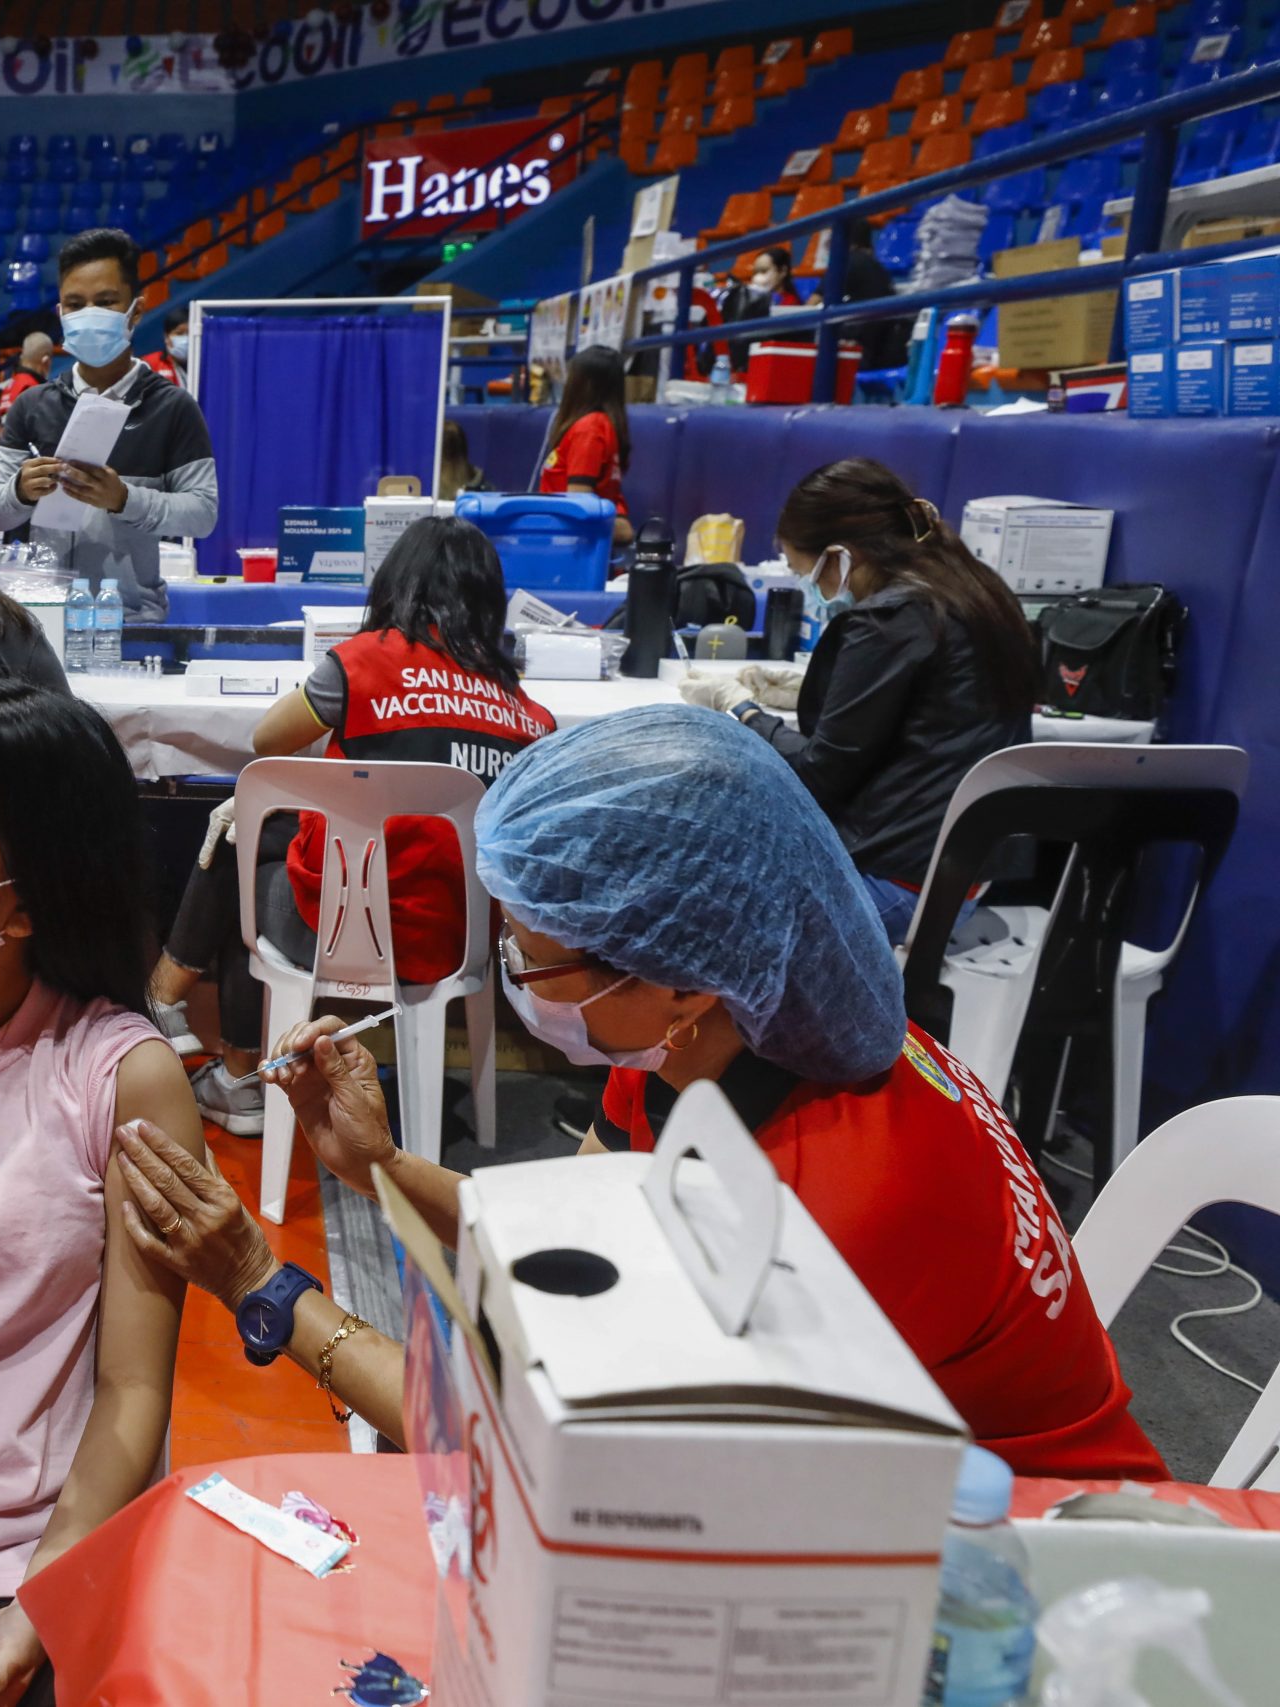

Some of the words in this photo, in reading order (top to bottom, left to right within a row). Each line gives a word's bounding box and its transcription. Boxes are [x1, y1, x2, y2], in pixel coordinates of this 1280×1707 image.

[365, 155, 552, 223] Hanes
[401, 667, 449, 689] SAN
[453, 673, 499, 700] JUAN
[370, 692, 516, 730] VACCINATION
